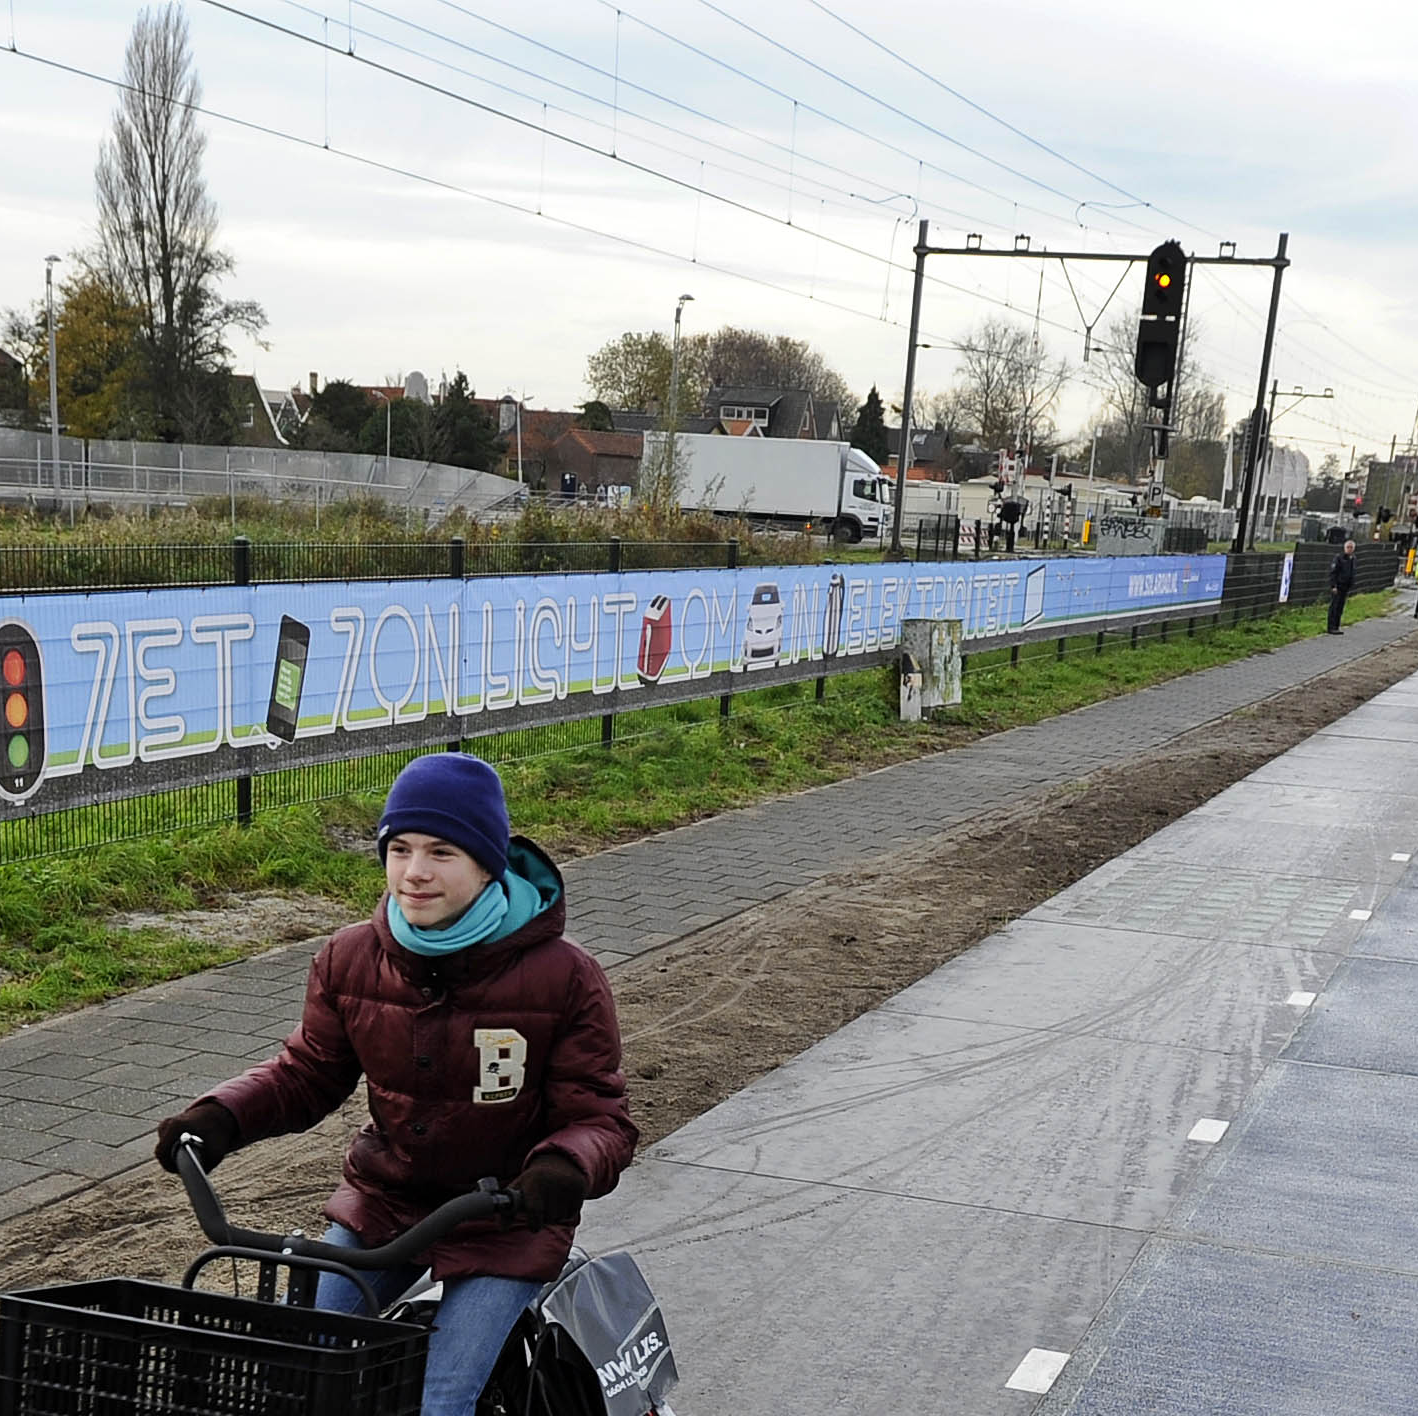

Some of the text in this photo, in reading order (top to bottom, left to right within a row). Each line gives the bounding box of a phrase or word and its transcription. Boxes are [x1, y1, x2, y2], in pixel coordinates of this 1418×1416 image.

[1152, 487, 1161, 501] P
[71, 612, 255, 770] ZET
[329, 590, 639, 732] ZONLICHT
[681, 586, 744, 680] OM
[473, 1029, 528, 1103] B
[597, 1351, 632, 1387] NW
